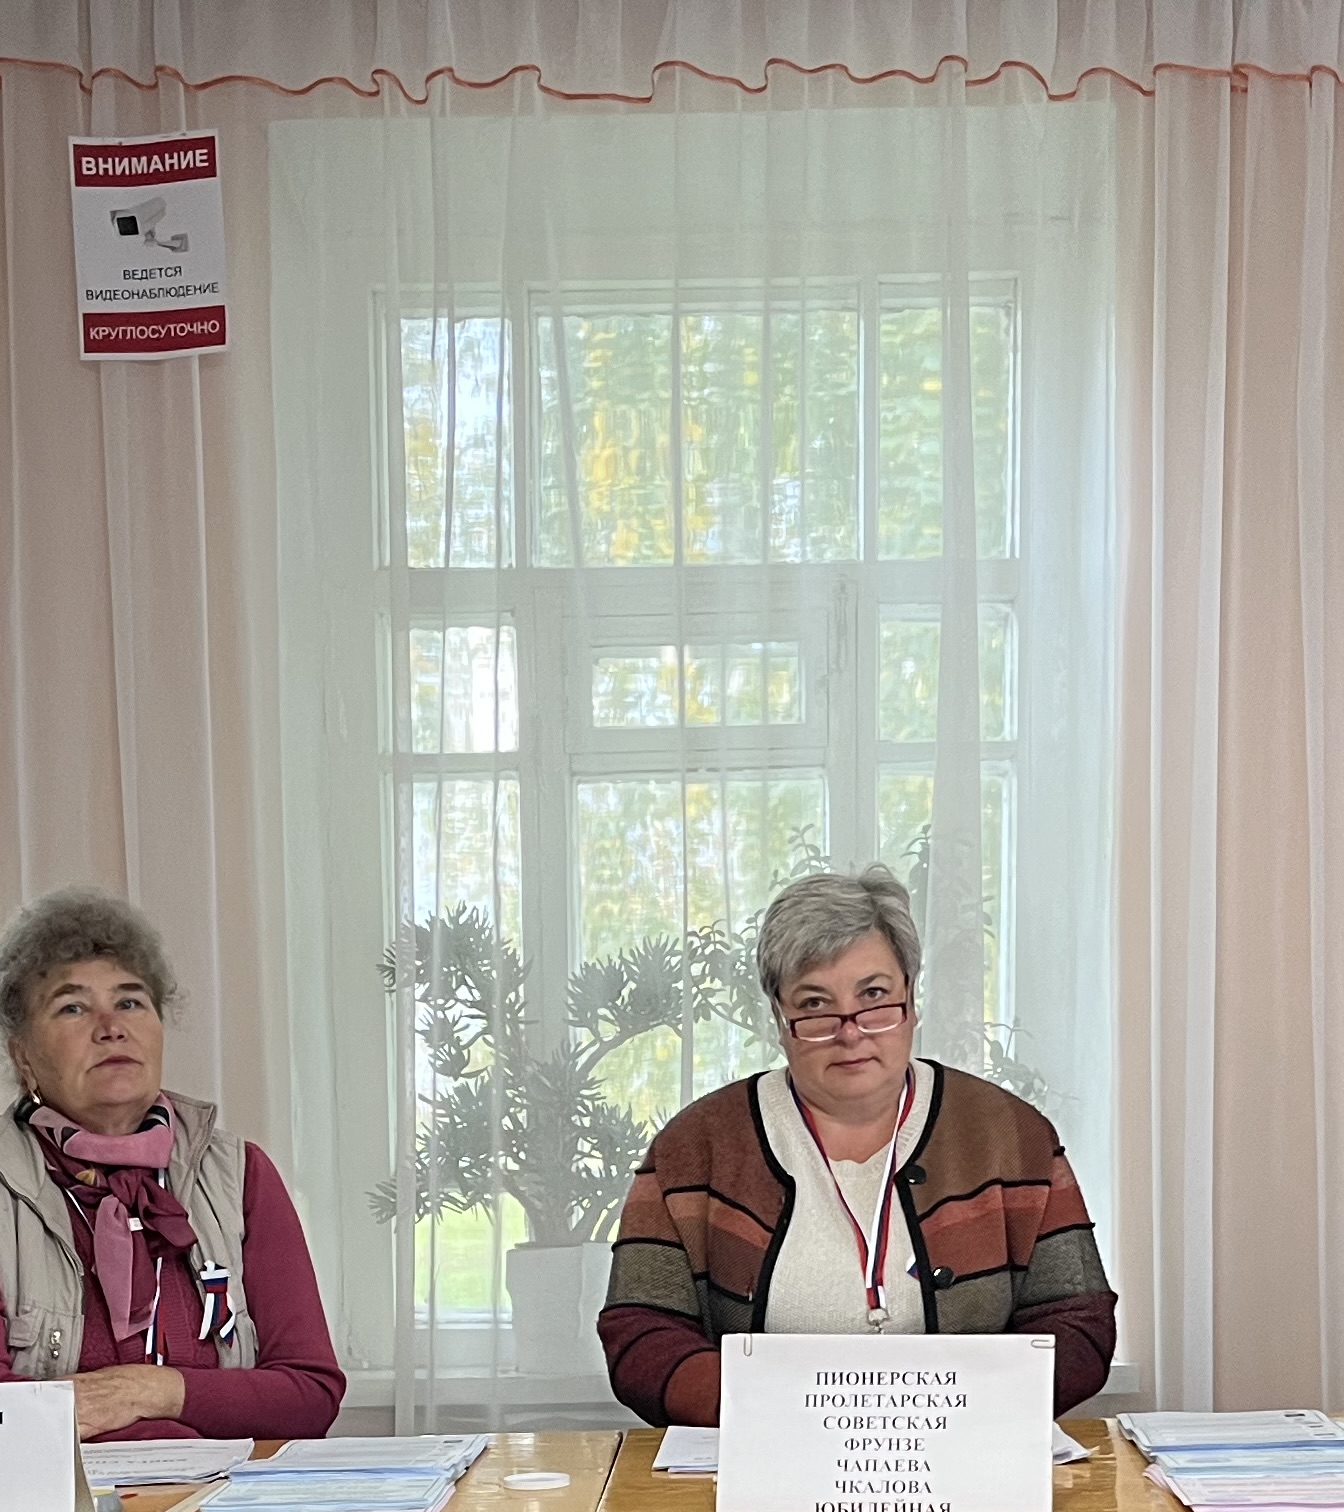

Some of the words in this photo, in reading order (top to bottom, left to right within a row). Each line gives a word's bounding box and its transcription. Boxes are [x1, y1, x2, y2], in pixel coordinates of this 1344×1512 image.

[81, 148, 210, 176] ВНИМАНИЕ
[122, 265, 183, 281] ВЕДЕТСЯ
[85, 281, 220, 302] ВИДЕОНАБЛЮДЕНИЕ
[89, 319, 220, 340] КРУГЛОСУТОЧНО
[816, 1371, 957, 1386] ПИОНЕРСКАЯ
[805, 1393, 967, 1408] ПРОЛЕТАРСКАЯ
[823, 1415, 947, 1430] СОВЕТСКАЯ
[845, 1437, 925, 1452] ФРУНЗЕ
[837, 1459, 931, 1472] ЧАПАЕВА
[835, 1480, 932, 1494] ЧКАЛОВА
